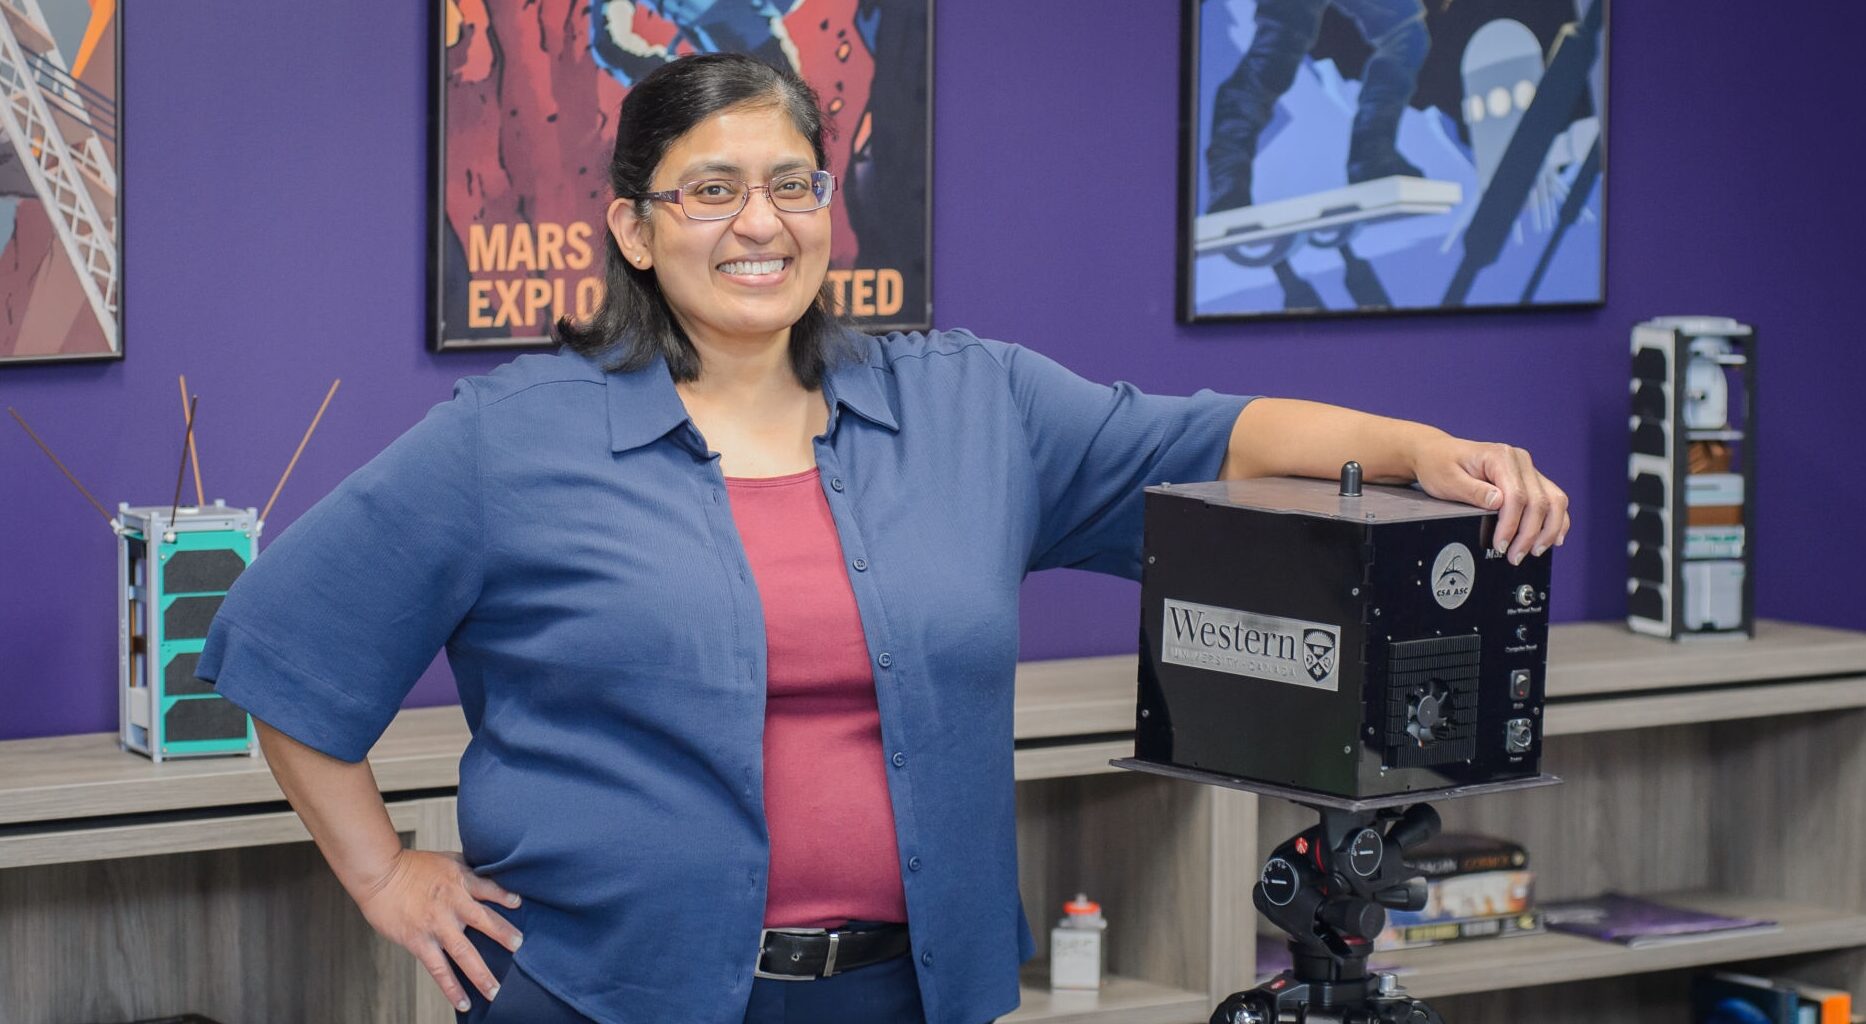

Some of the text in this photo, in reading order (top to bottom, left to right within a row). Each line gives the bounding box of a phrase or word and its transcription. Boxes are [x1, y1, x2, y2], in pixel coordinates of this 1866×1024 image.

[469, 221, 592, 272] MARS
[469, 268, 904, 329] EXPLO TED
[1436, 587, 1469, 597] CSA ASC
[1169, 606, 1298, 662] Western
[1174, 647, 1297, 677] UNIVERSITY CANADA
